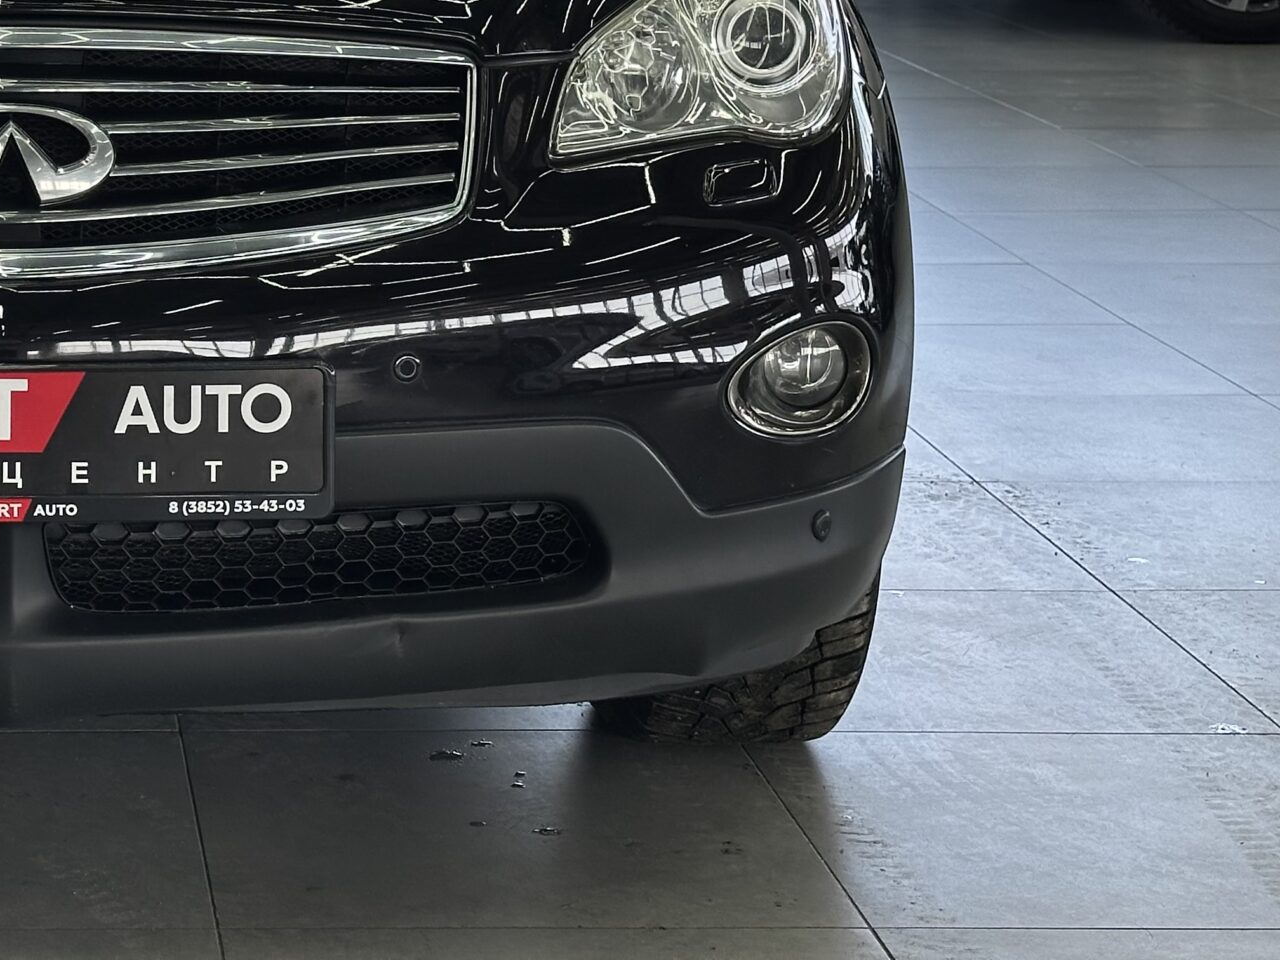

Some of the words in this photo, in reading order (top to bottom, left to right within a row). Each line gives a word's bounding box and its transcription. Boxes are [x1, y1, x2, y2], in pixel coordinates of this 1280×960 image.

[113, 383, 293, 434] AUTO
[33, 503, 78, 517] AUTO
[168, 501, 179, 514] 8
[182, 500, 231, 517] (3852)
[233, 499, 306, 513] 53-43-03
